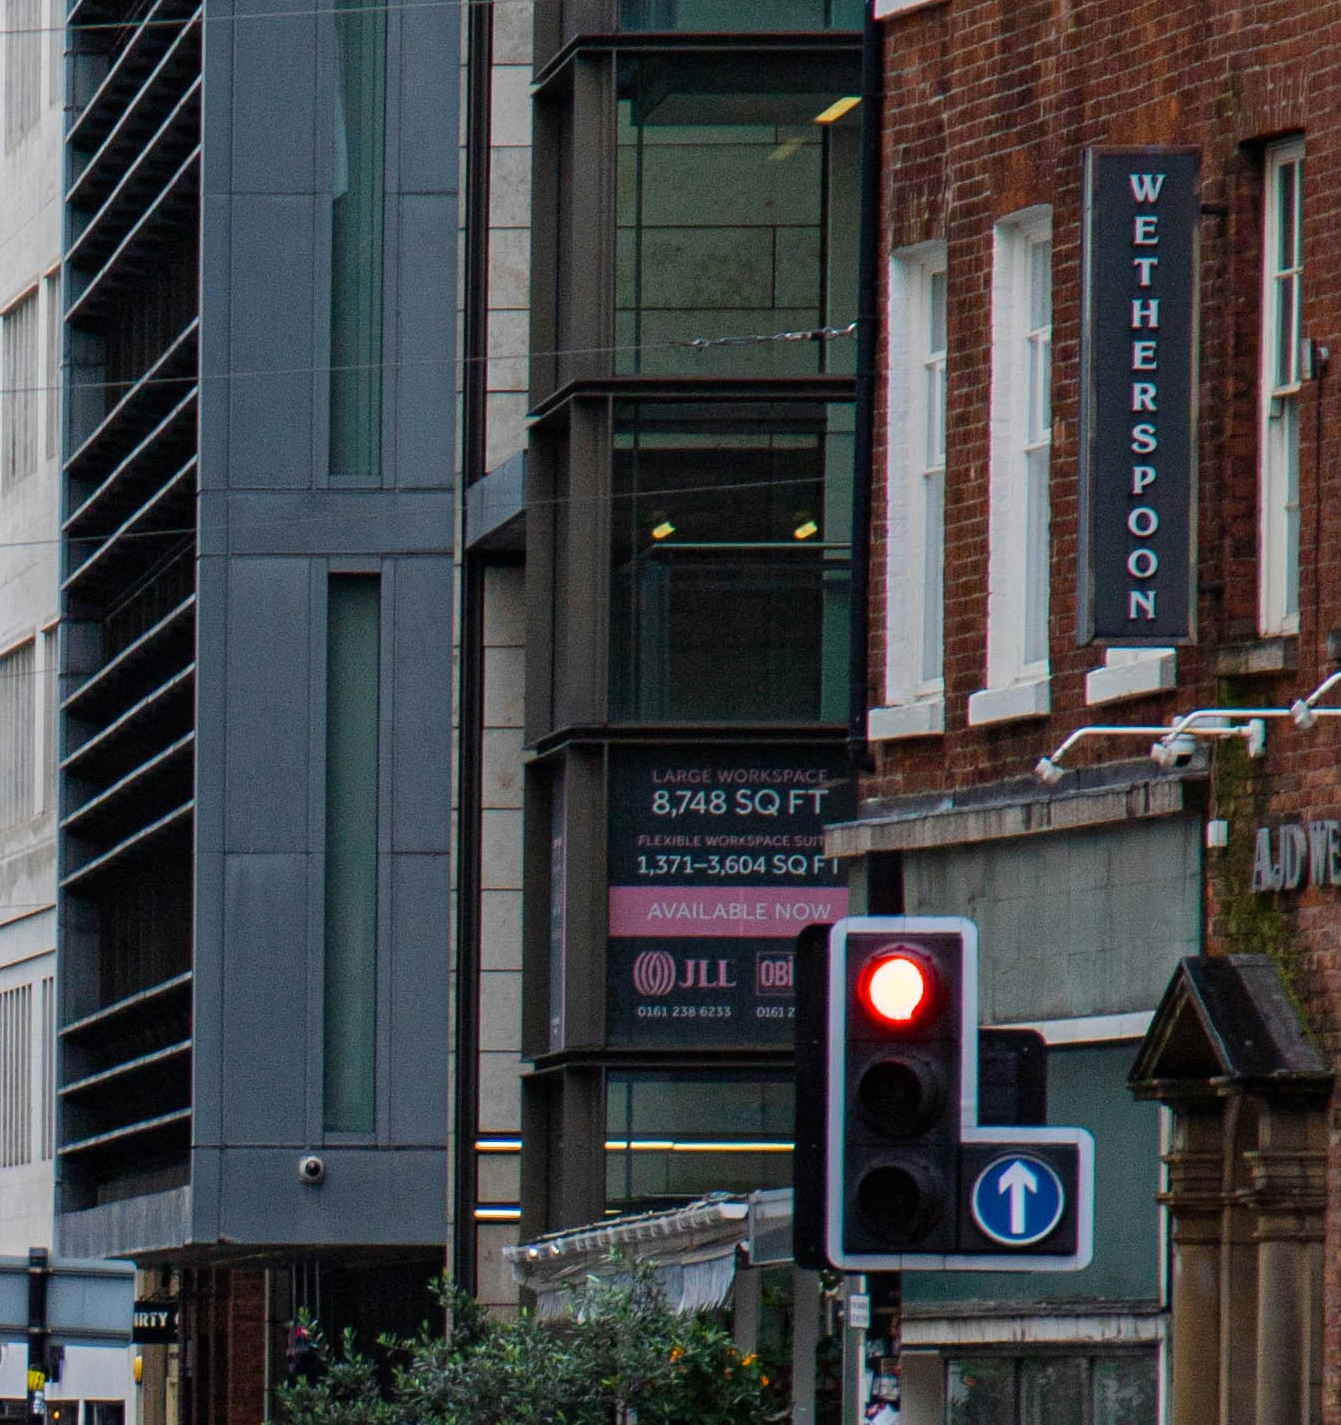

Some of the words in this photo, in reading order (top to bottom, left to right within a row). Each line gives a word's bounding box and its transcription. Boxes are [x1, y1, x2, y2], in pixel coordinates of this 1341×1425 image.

[1127, 173, 1166, 621] WETHERSPOON
[652, 769, 713, 784] LARGE
[718, 769, 828, 784] WORKSPACE
[652, 789, 728, 818] 8,748
[734, 788, 781, 816] SQ
[788, 789, 829, 815] FT
[637, 835, 701, 848] FLEXIBLE
[705, 835, 791, 848] WORKSPACE
[793, 835, 825, 848] SUIT
[772, 854, 808, 875] SQ
[647, 902, 768, 921] AVAILABLE
[775, 902, 832, 921] NOW
[679, 959, 737, 988] JLL
[638, 1006, 668, 1018] 0161
[672, 1006, 697, 1018] 238
[699, 1006, 732, 1018] 6233
[756, 1006, 784, 1018] 0161
